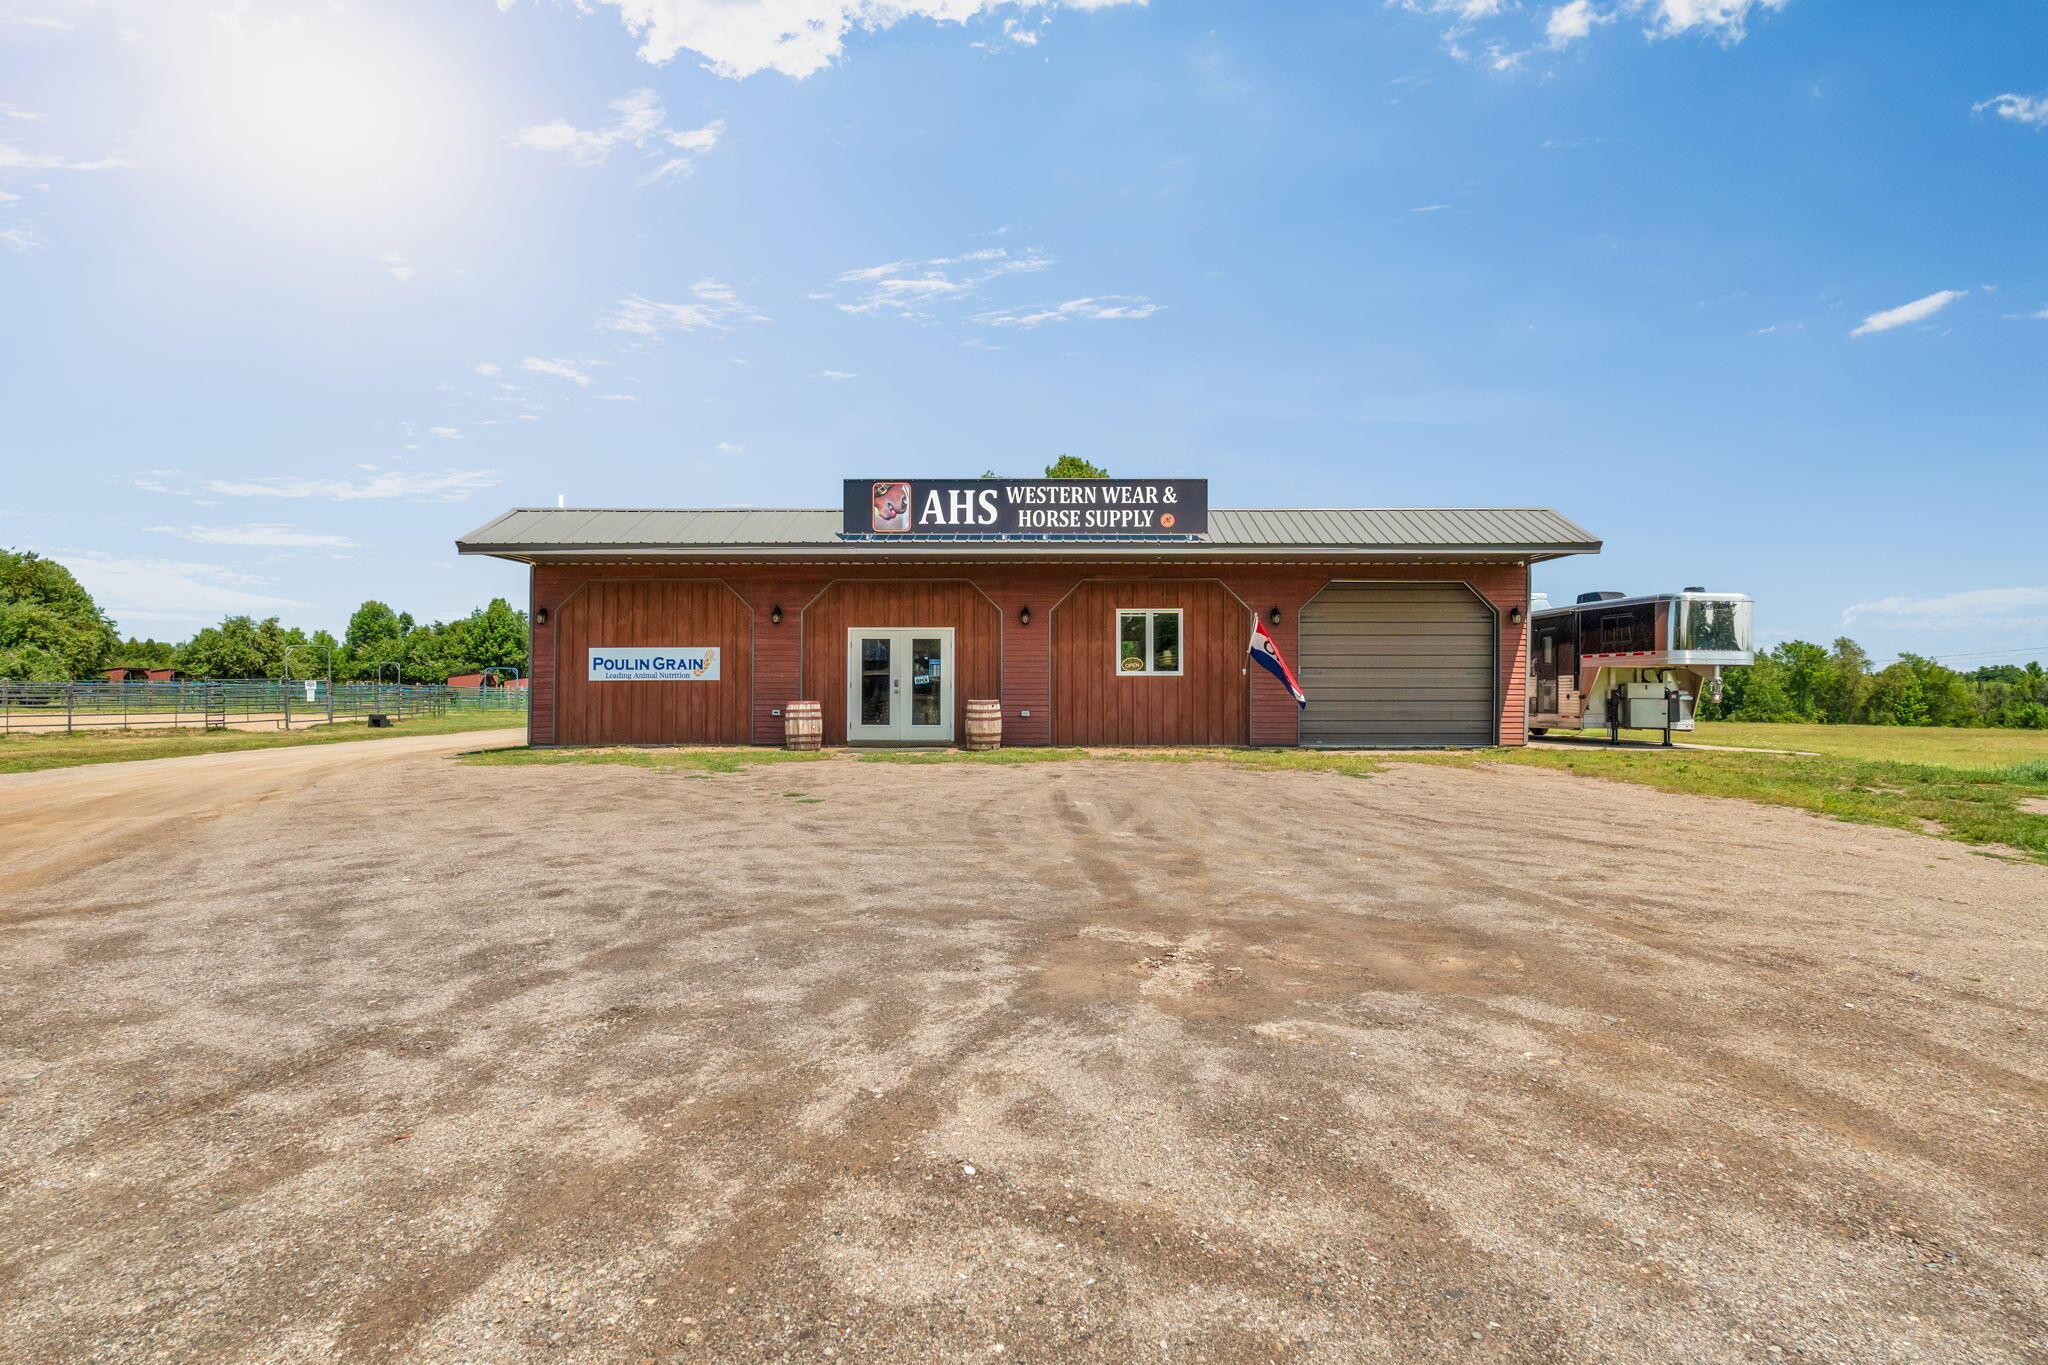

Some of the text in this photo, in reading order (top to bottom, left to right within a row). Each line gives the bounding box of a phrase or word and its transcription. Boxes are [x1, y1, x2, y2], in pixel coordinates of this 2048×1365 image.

[1005, 486, 1178, 504] WESTERN WEAR &
[918, 489, 998, 525] AHS
[1018, 510, 1081, 528] HORSE
[1085, 510, 1155, 528] SUPPLY
[593, 656, 704, 671] POULIN GRAIN
[605, 672, 632, 680] Leading
